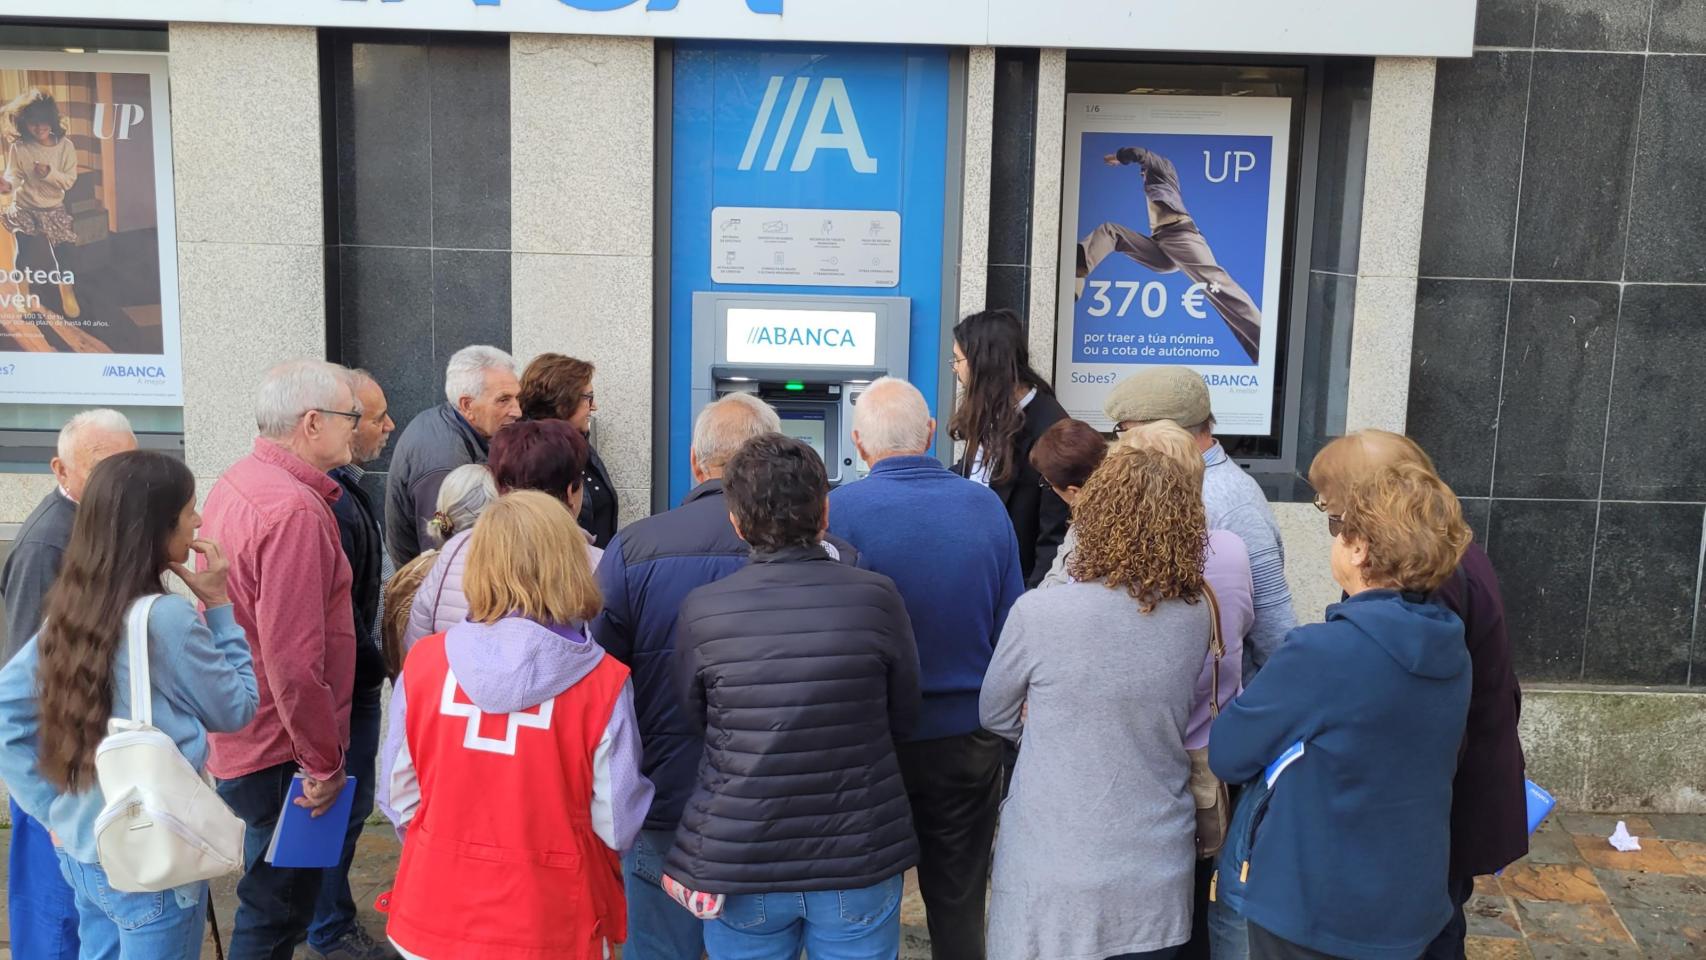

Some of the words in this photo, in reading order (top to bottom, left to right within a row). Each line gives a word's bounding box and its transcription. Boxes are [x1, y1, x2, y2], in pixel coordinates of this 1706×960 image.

[1085, 105, 1100, 113] 1/6
[92, 103, 145, 140] UP
[1203, 150, 1256, 183] UP
[1087, 280, 1168, 318] 370
[1084, 334, 1103, 346] por
[1107, 333, 1134, 344] traer
[1148, 333, 1166, 343] túa
[1169, 333, 1213, 344] nómina
[1083, 346, 1099, 355] ou
[1101, 347, 1109, 355] a
[1112, 346, 1137, 356] cota
[1140, 346, 1155, 356] de
[1158, 346, 1220, 357] autónomo
[1071, 372, 1117, 384] Sobes?
